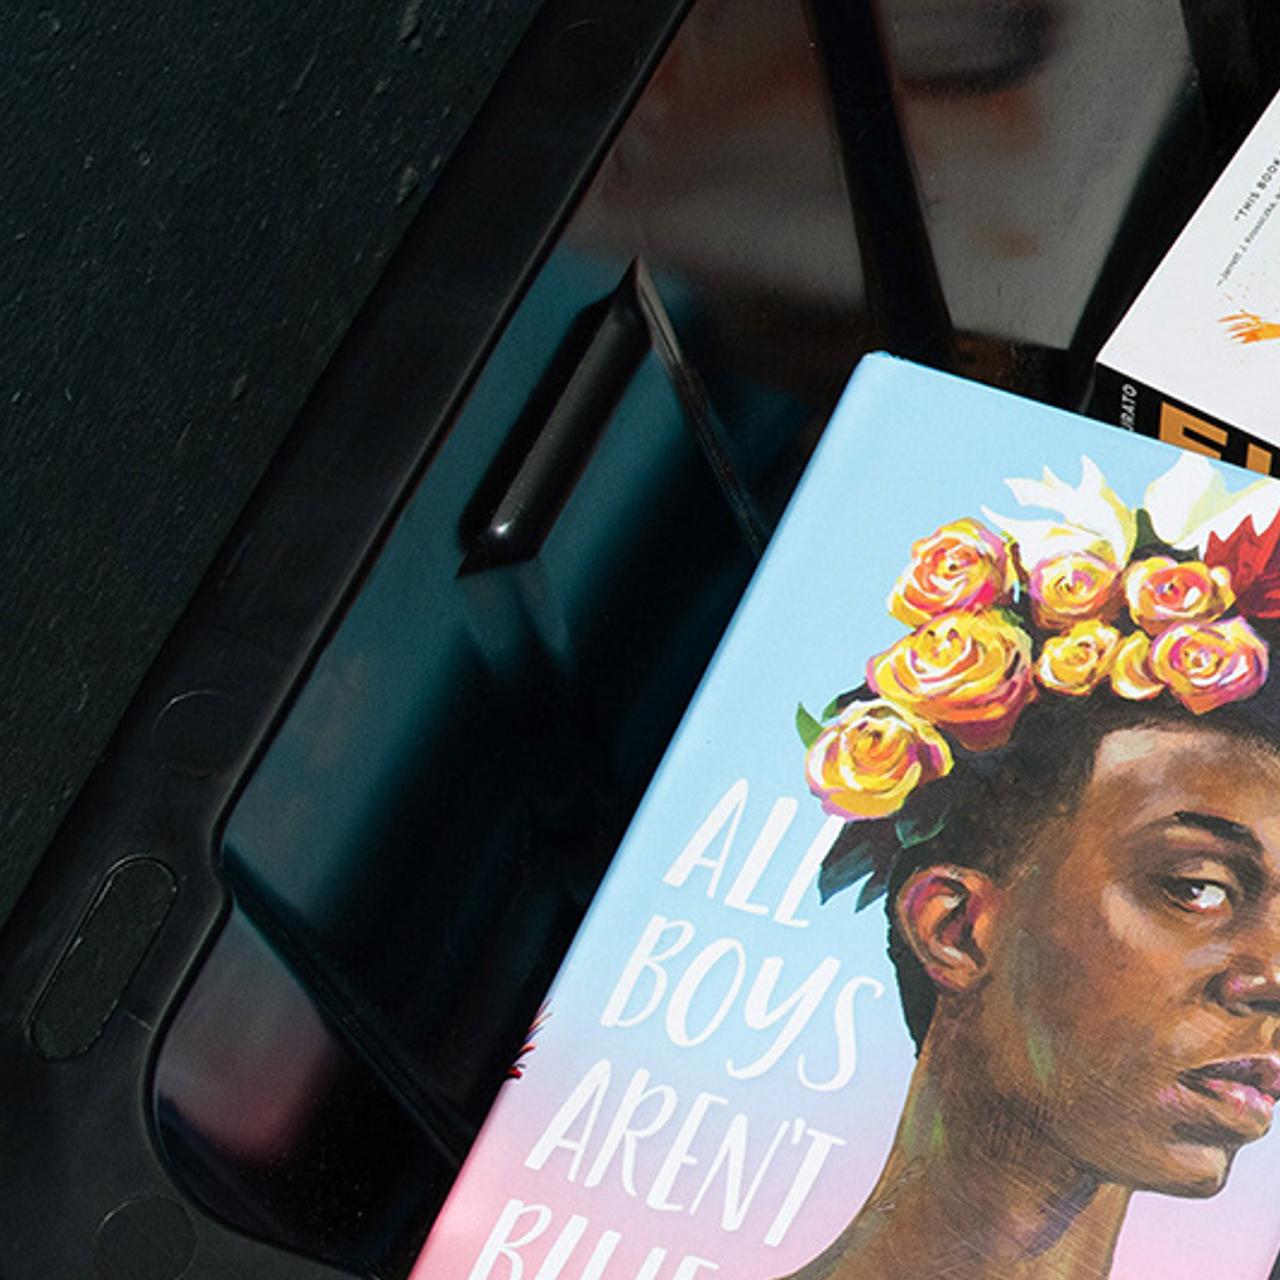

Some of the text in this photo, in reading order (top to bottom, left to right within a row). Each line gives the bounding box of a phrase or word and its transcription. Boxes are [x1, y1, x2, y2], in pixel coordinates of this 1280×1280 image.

[1257, 158, 1280, 188] BOOK
[662, 777, 849, 928] ALL
[599, 915, 884, 1091] BOYS
[524, 1057, 846, 1246] AREN'T
